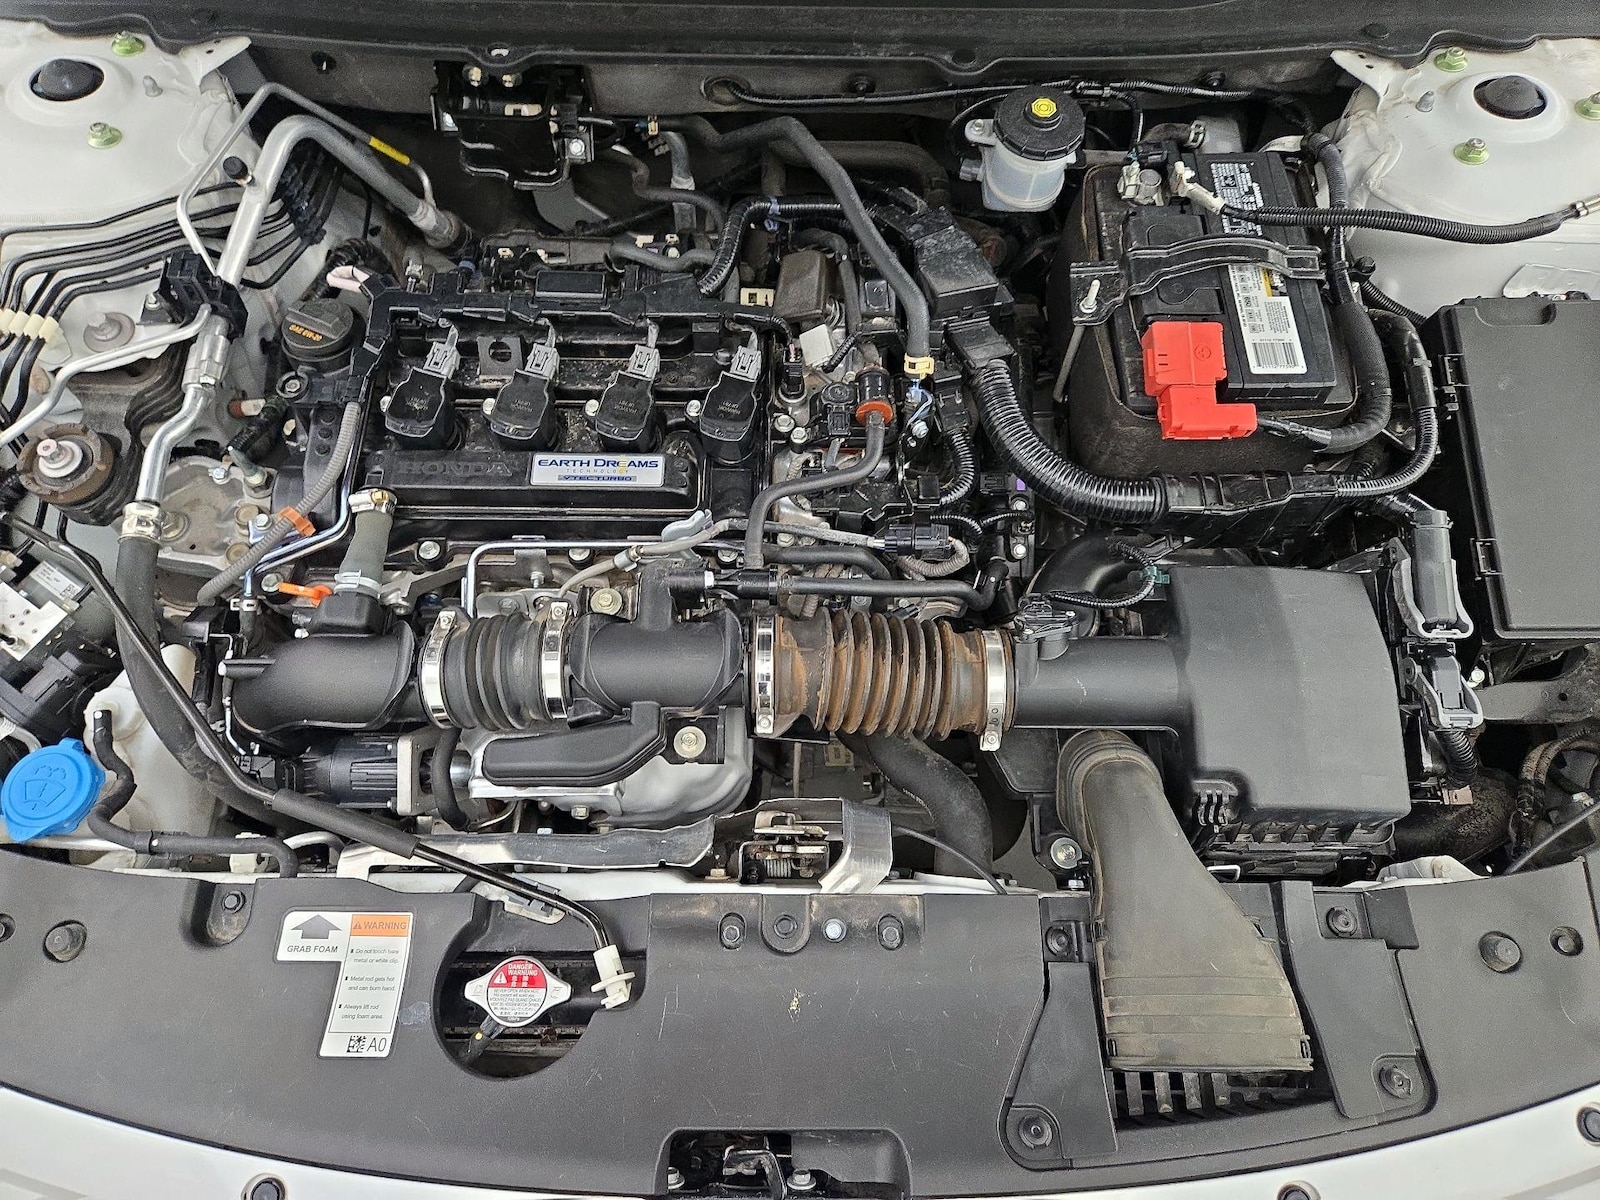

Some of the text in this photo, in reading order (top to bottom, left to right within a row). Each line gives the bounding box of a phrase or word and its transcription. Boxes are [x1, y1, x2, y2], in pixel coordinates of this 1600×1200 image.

[538, 458, 658, 468] EARTH DREAMS
[400, 461, 512, 477] HONDA
[364, 921, 407, 930] WARNING
[287, 945, 338, 953] GRAB FOAM
